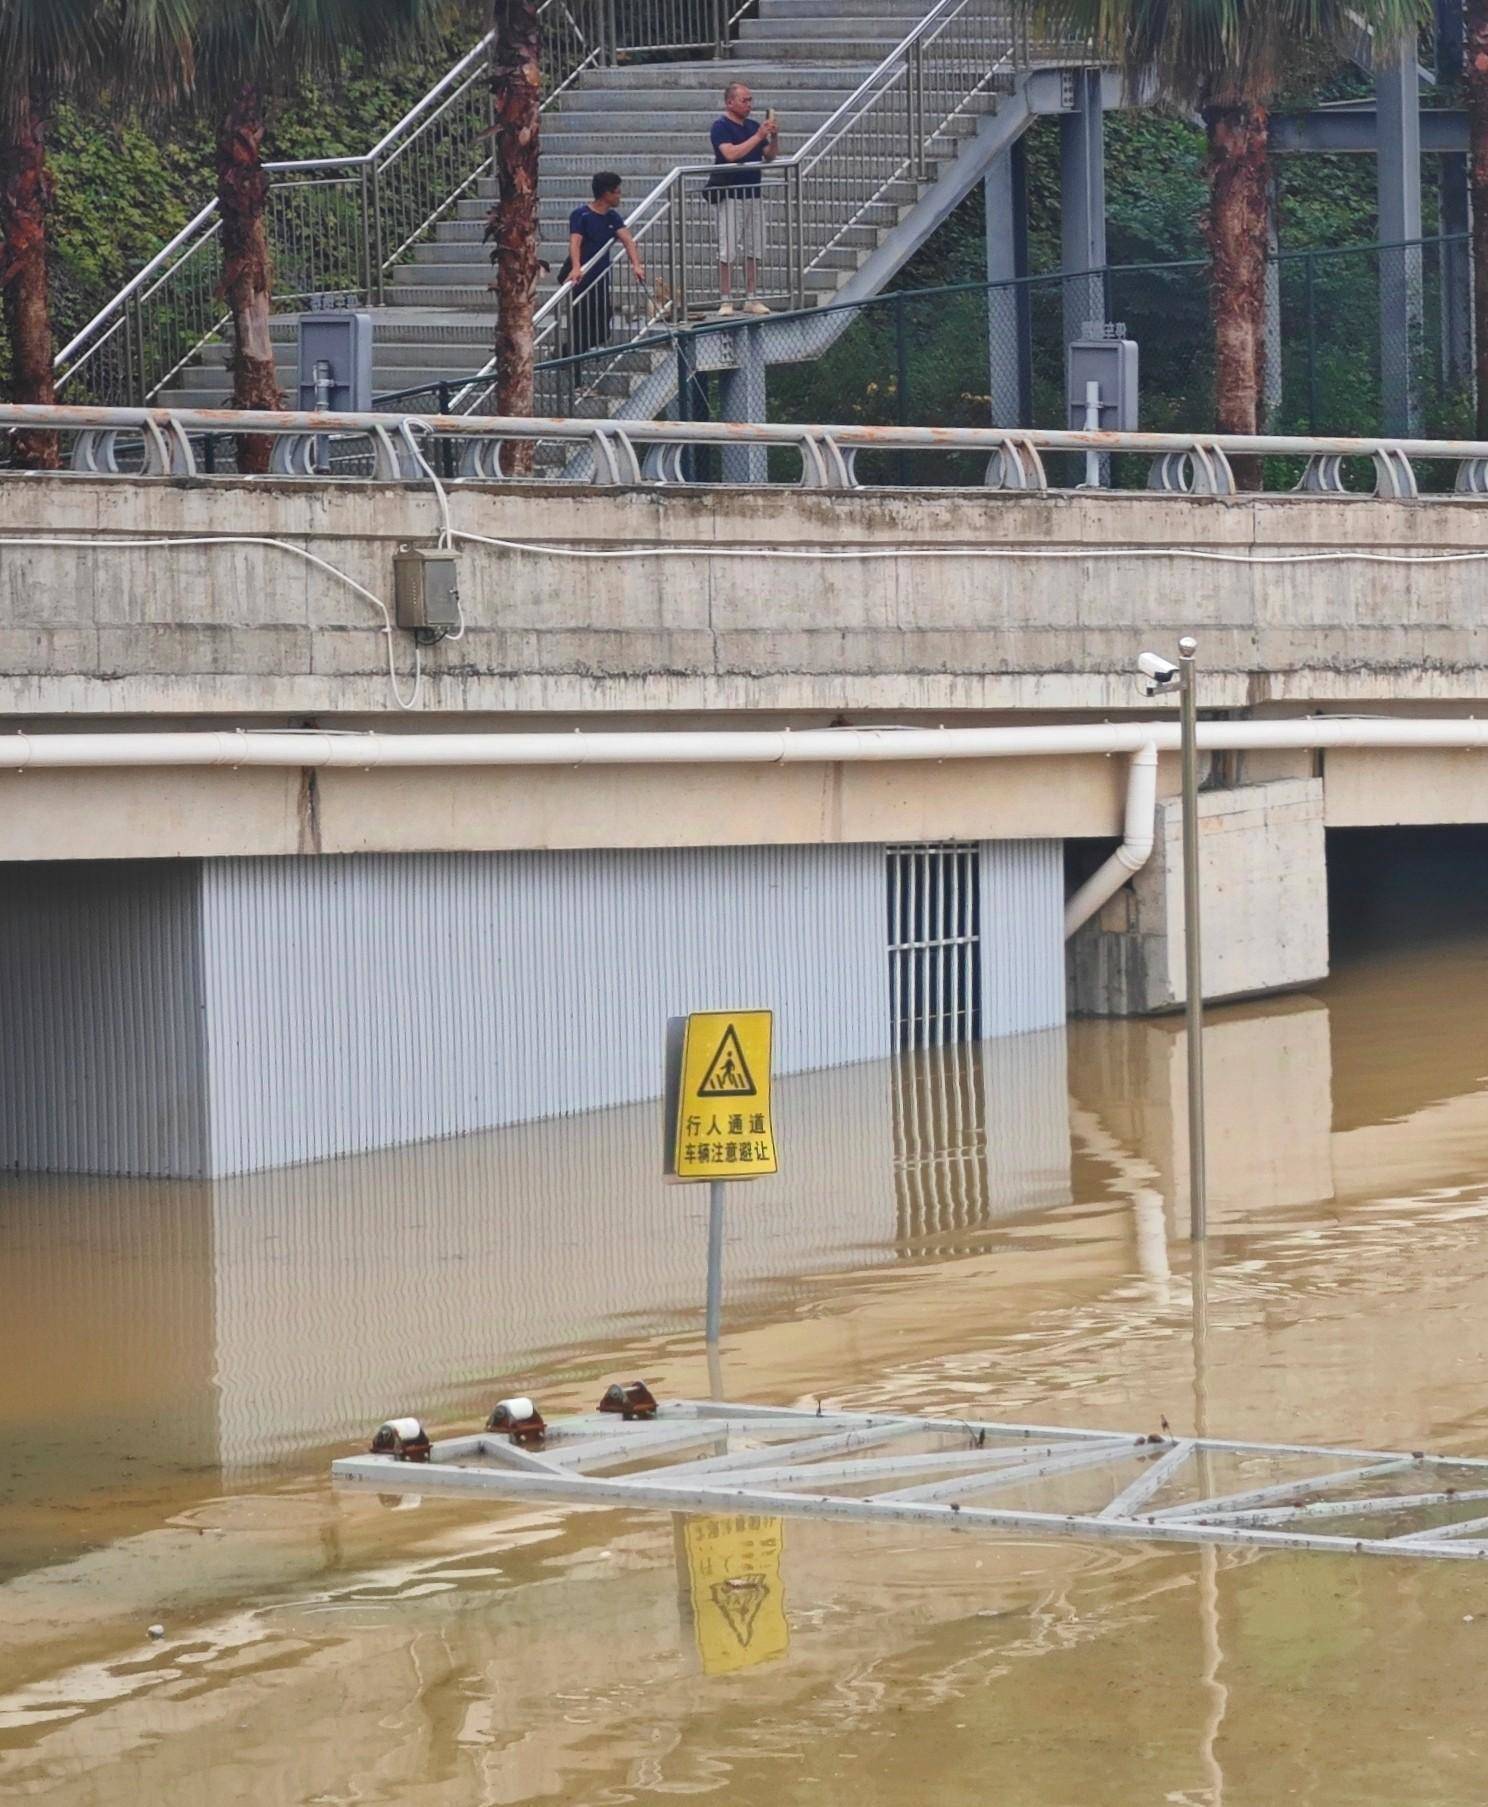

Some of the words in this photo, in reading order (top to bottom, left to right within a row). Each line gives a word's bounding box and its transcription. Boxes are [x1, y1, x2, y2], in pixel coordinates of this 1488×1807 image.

[686, 1113, 767, 1137] 行人通道
[685, 1142, 770, 1164] 车辆注意避让
